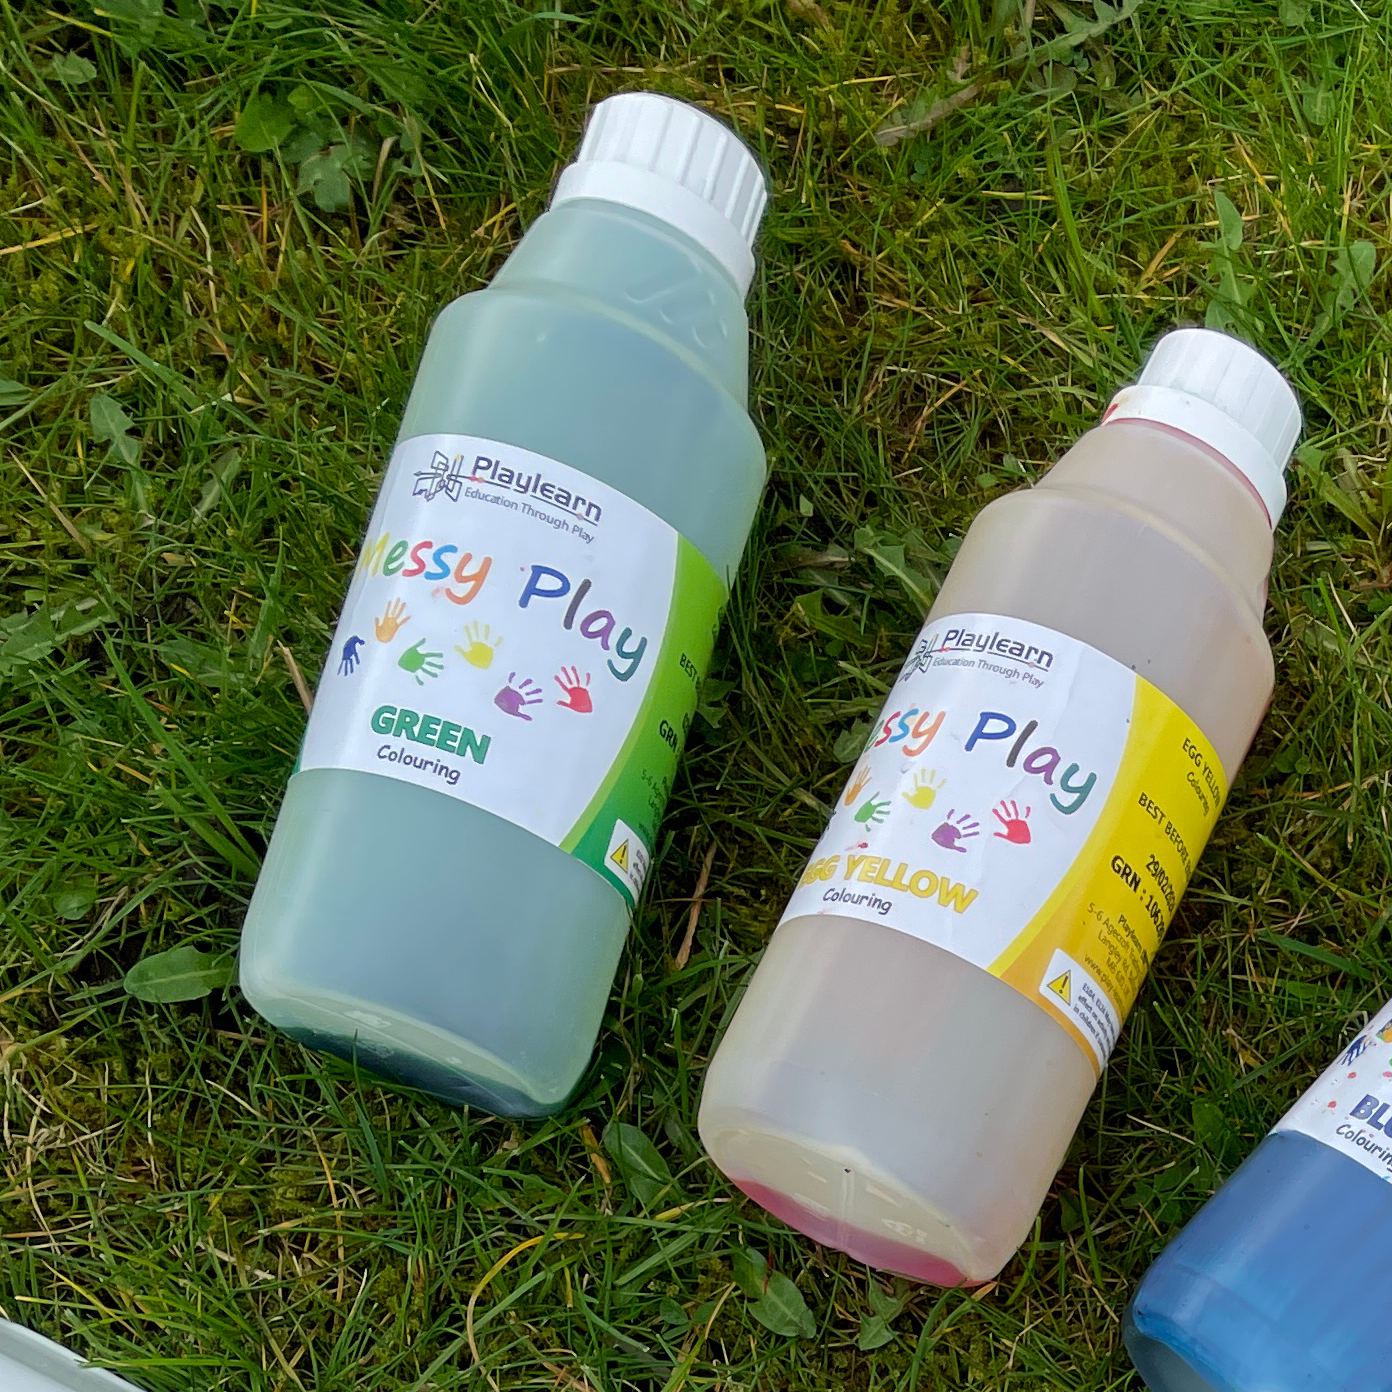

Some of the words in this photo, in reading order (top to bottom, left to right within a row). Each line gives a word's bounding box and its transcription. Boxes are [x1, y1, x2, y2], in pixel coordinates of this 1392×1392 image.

[472, 455, 603, 523] Playlearn
[464, 486, 519, 511] Education
[521, 502, 570, 532] Through
[571, 524, 595, 545] Play
[518, 564, 649, 682] Play
[941, 628, 1054, 668] Playlearn
[932, 656, 976, 668] Education
[977, 658, 1020, 680] Through
[1021, 671, 1045, 689] Play
[371, 704, 492, 765] GREEN
[1182, 737, 1204, 768] EGG
[376, 744, 462, 786] Colouring
[863, 707, 947, 758] essy
[964, 711, 1098, 816] Play
[1138, 792, 1167, 825] BEST
[843, 854, 980, 915] YELLOW
[1110, 854, 1142, 894] GRN
[822, 887, 893, 916] Colouring
